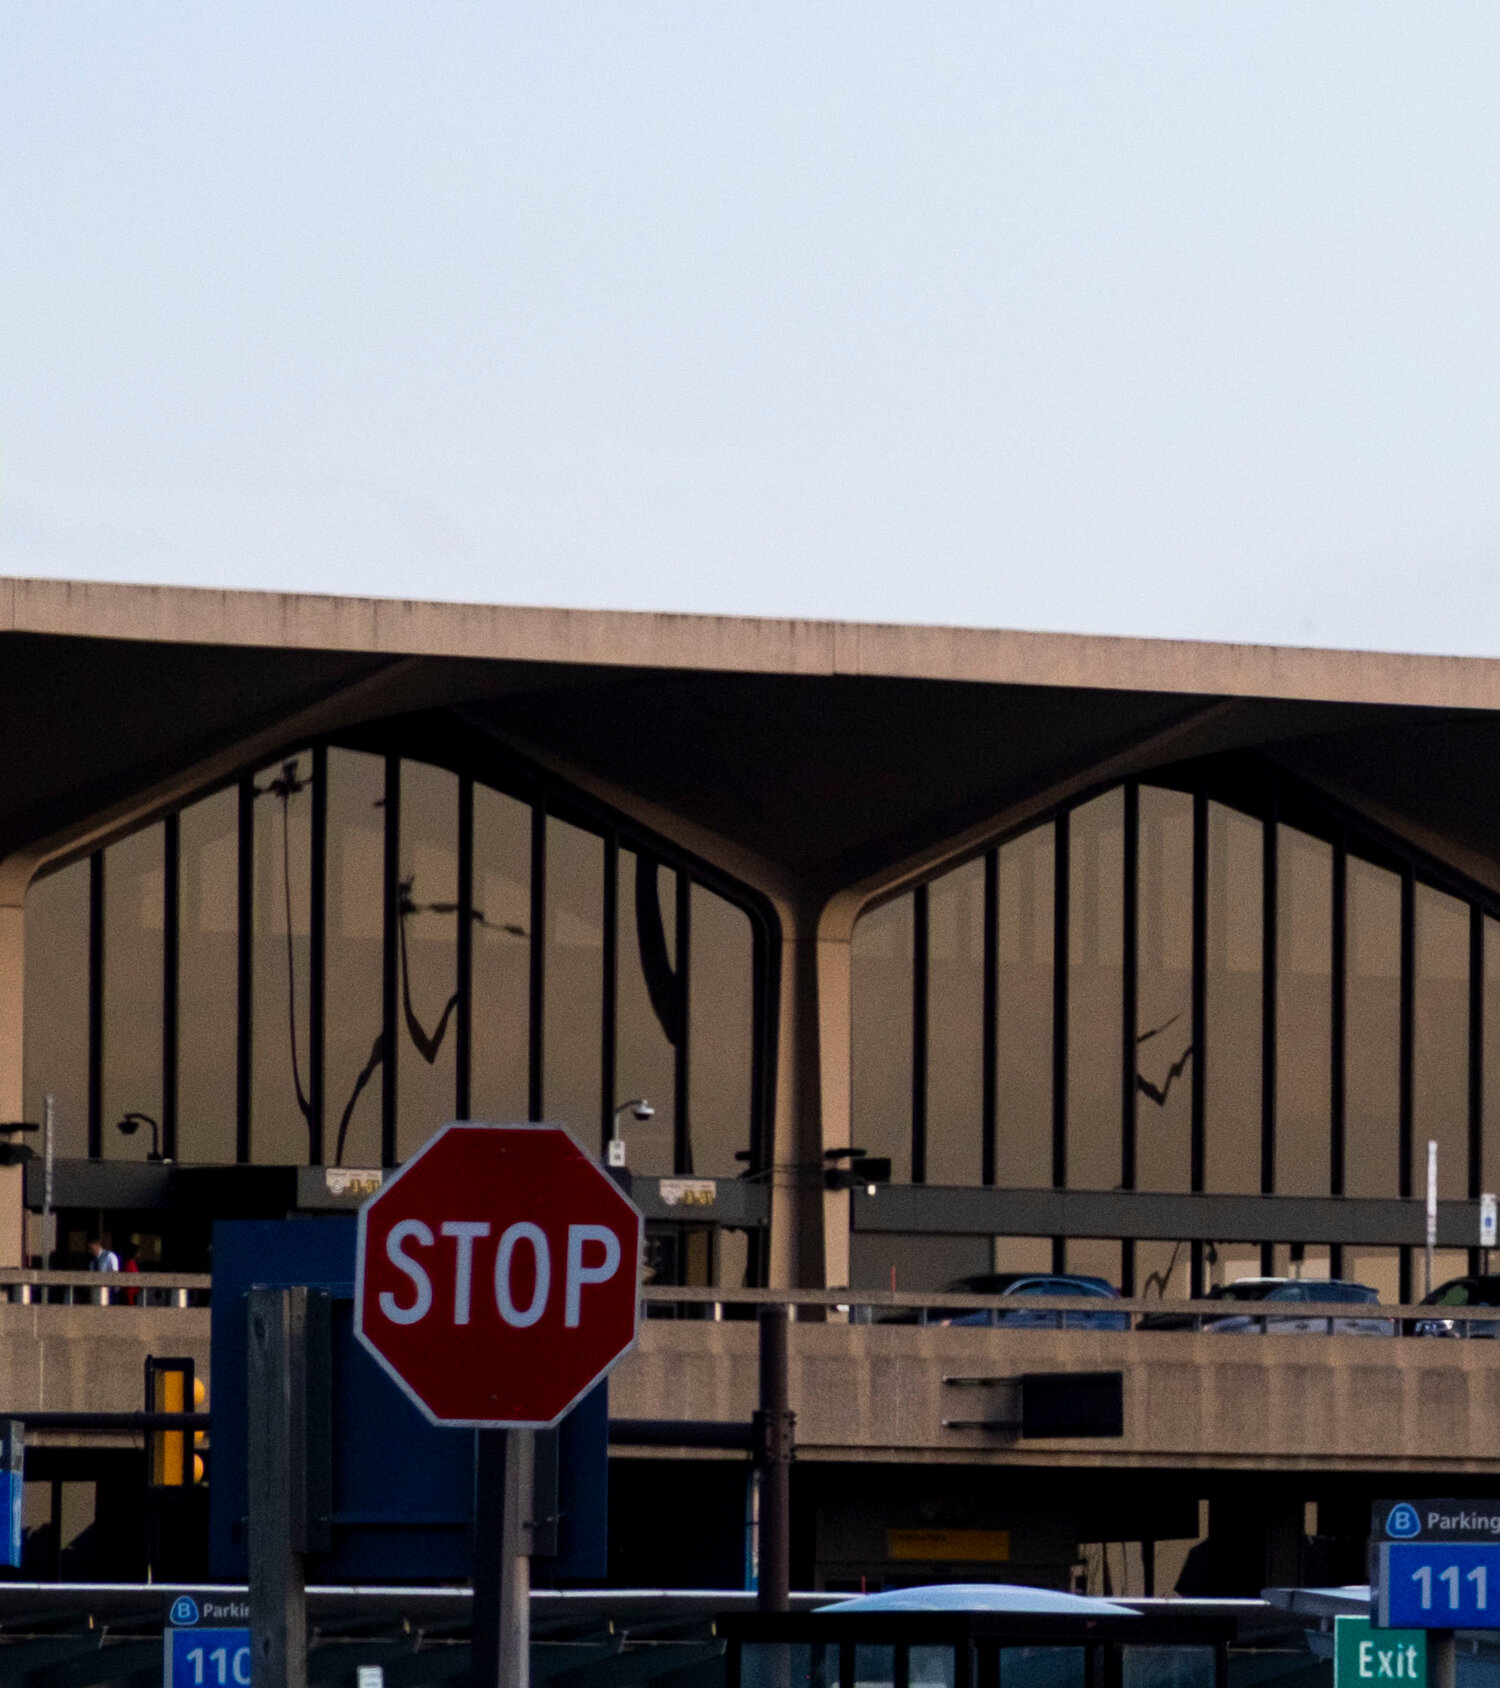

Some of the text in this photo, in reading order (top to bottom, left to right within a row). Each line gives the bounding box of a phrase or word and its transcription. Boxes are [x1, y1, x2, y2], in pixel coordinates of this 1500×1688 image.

[379, 1218, 621, 1328] STOP
[1394, 1511, 1411, 1530] B
[1411, 1565, 1487, 1610] 111
[178, 1602, 191, 1618] B
[1359, 1640, 1418, 1679] Exit
